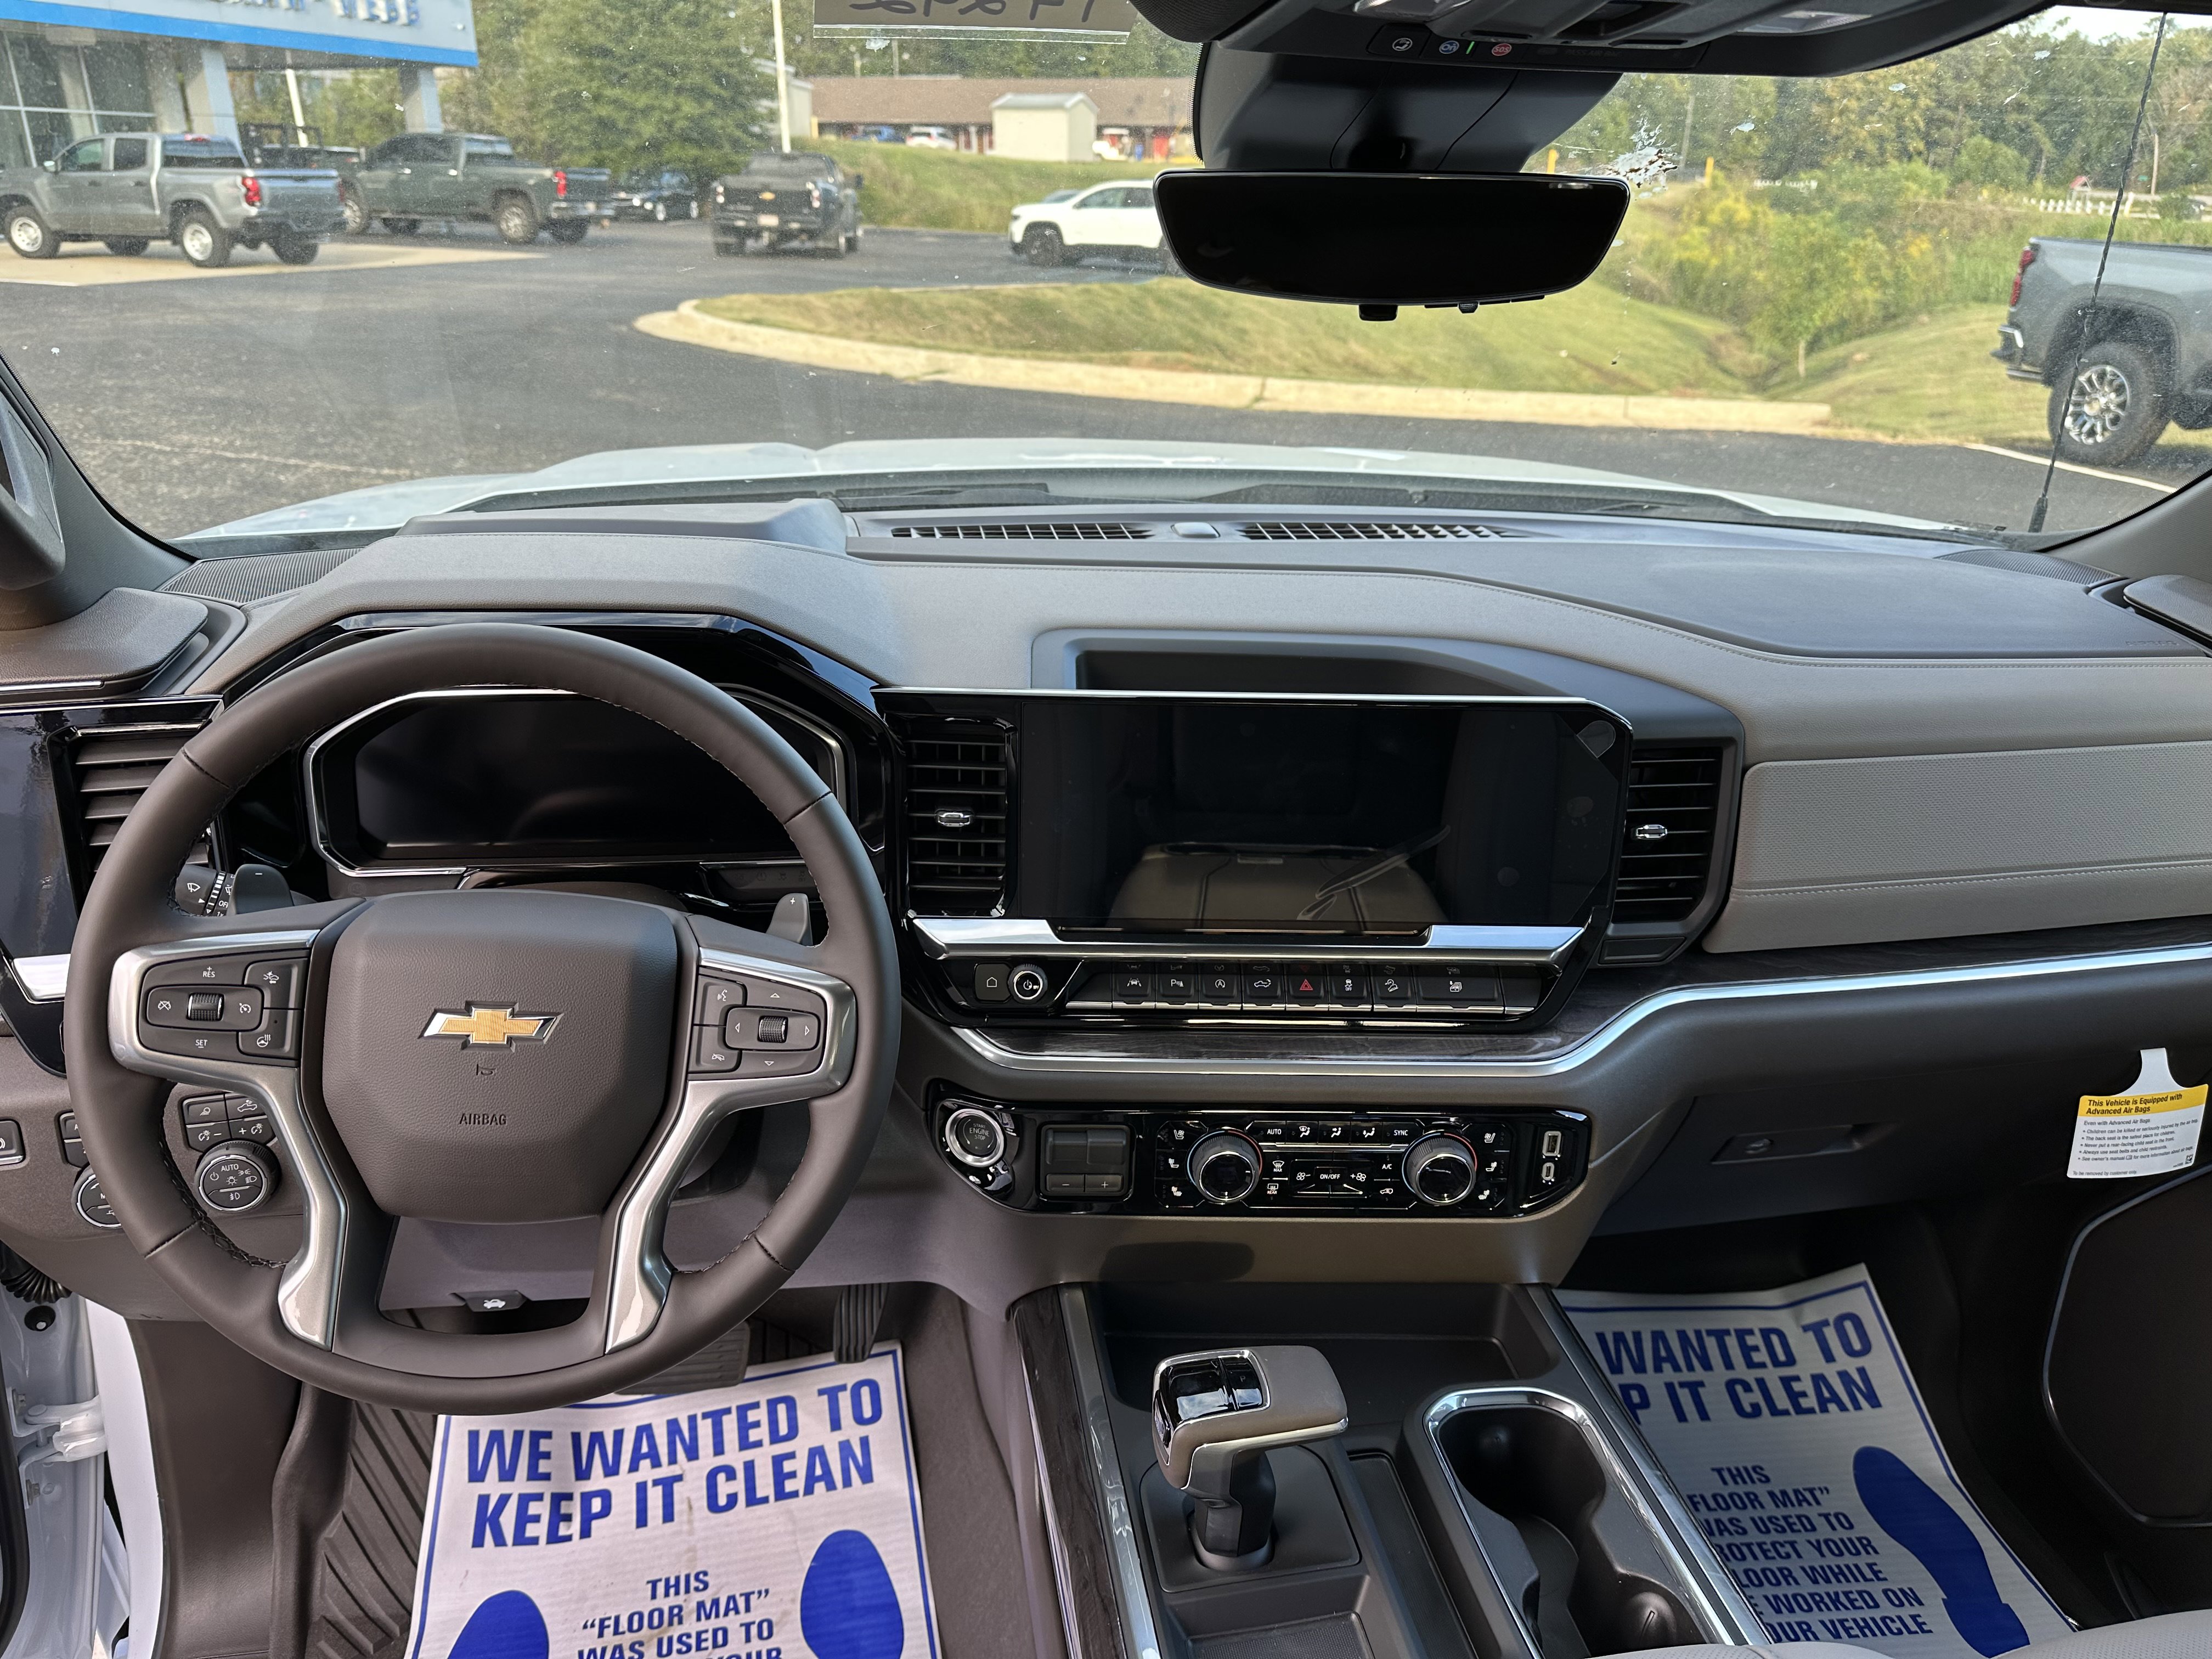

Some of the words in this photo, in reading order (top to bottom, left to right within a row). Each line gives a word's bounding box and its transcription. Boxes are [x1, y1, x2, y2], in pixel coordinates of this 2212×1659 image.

[2140, 1096, 2168, 1104] Equipped
[459, 1113, 507, 1125] AIRBAG
[969, 1127, 990, 1137] ENGINE
[221, 1164, 239, 1172] AUTO
[1595, 1327, 1797, 1376] WANTED
[1802, 1311, 1872, 1364] TO
[1663, 1380, 1712, 1424] IT
[1724, 1365, 1882, 1419] CLEAN
[467, 1429, 553, 1482] WE
[571, 1395, 799, 1481] WANTED
[817, 1379, 882, 1432] TO
[1711, 1464, 1770, 1486] THIS
[472, 1488, 612, 1548] KEEP
[635, 1474, 684, 1530] IT
[706, 1435, 874, 1514] CLEAN
[1750, 1513, 1818, 1536] USED
[1817, 1511, 1854, 1532] TO
[1713, 1538, 1803, 1562] ROTECT
[1806, 1536, 1880, 1559] YOUR
[646, 1570, 709, 1600] THIS
[1731, 1565, 1801, 1589] LOOR
[1800, 1562, 1888, 1585] WHILE
[1763, 1589, 1880, 1615] WORKED
[1881, 1587, 1925, 1609] ON
[656, 1626, 729, 1658] USED
[740, 1618, 774, 1644] TO
[1764, 1620, 1821, 1644] OUR
[1818, 1613, 1933, 1640] VEHICLE
